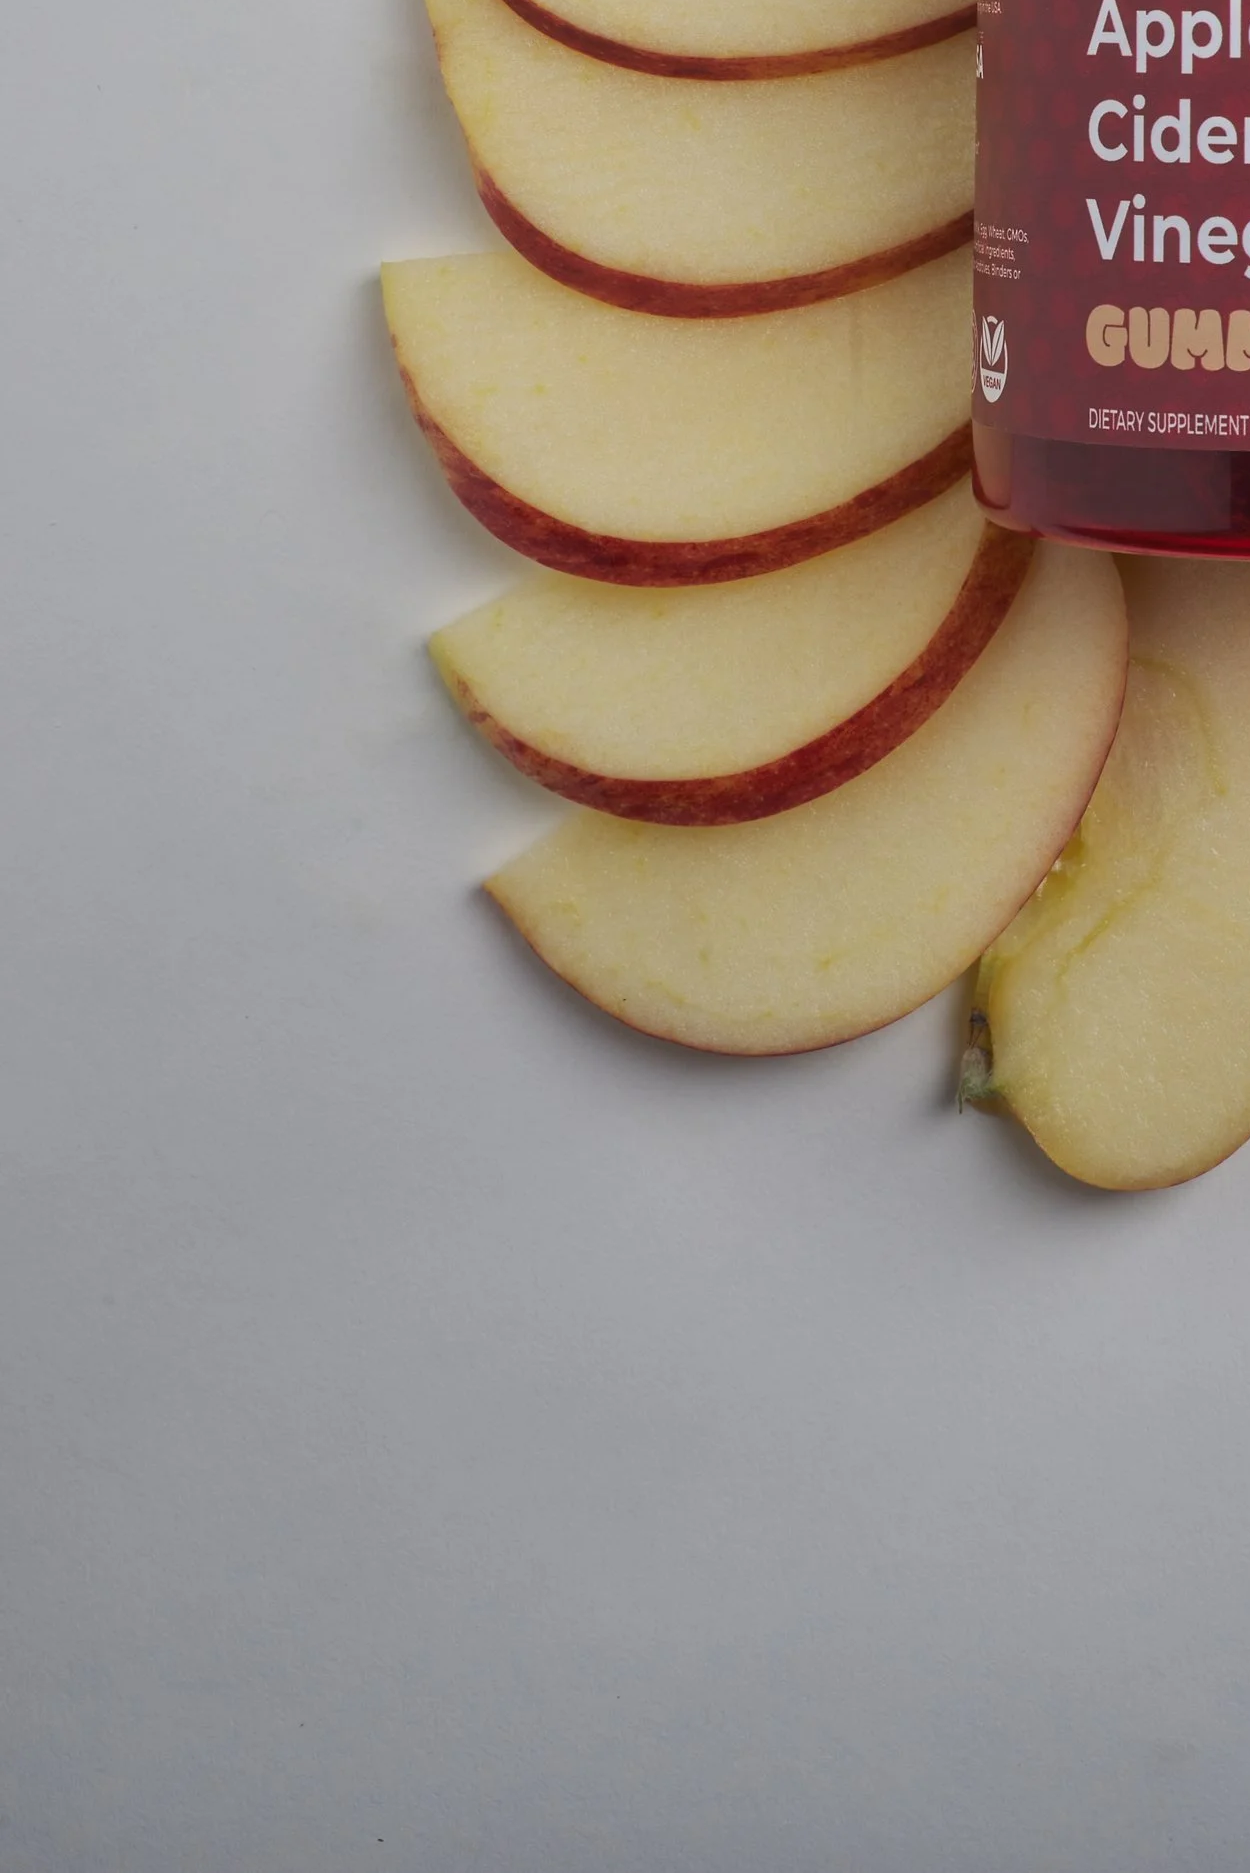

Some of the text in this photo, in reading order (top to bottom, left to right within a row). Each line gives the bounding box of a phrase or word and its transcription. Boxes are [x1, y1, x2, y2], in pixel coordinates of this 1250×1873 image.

[991, 263, 1012, 279] Binders
[1013, 269, 1021, 280] or
[982, 375, 1002, 390] VEGAN
[1089, 408, 1145, 432] DIETARY
[1147, 411, 1250, 437] SUPPLEMENT
